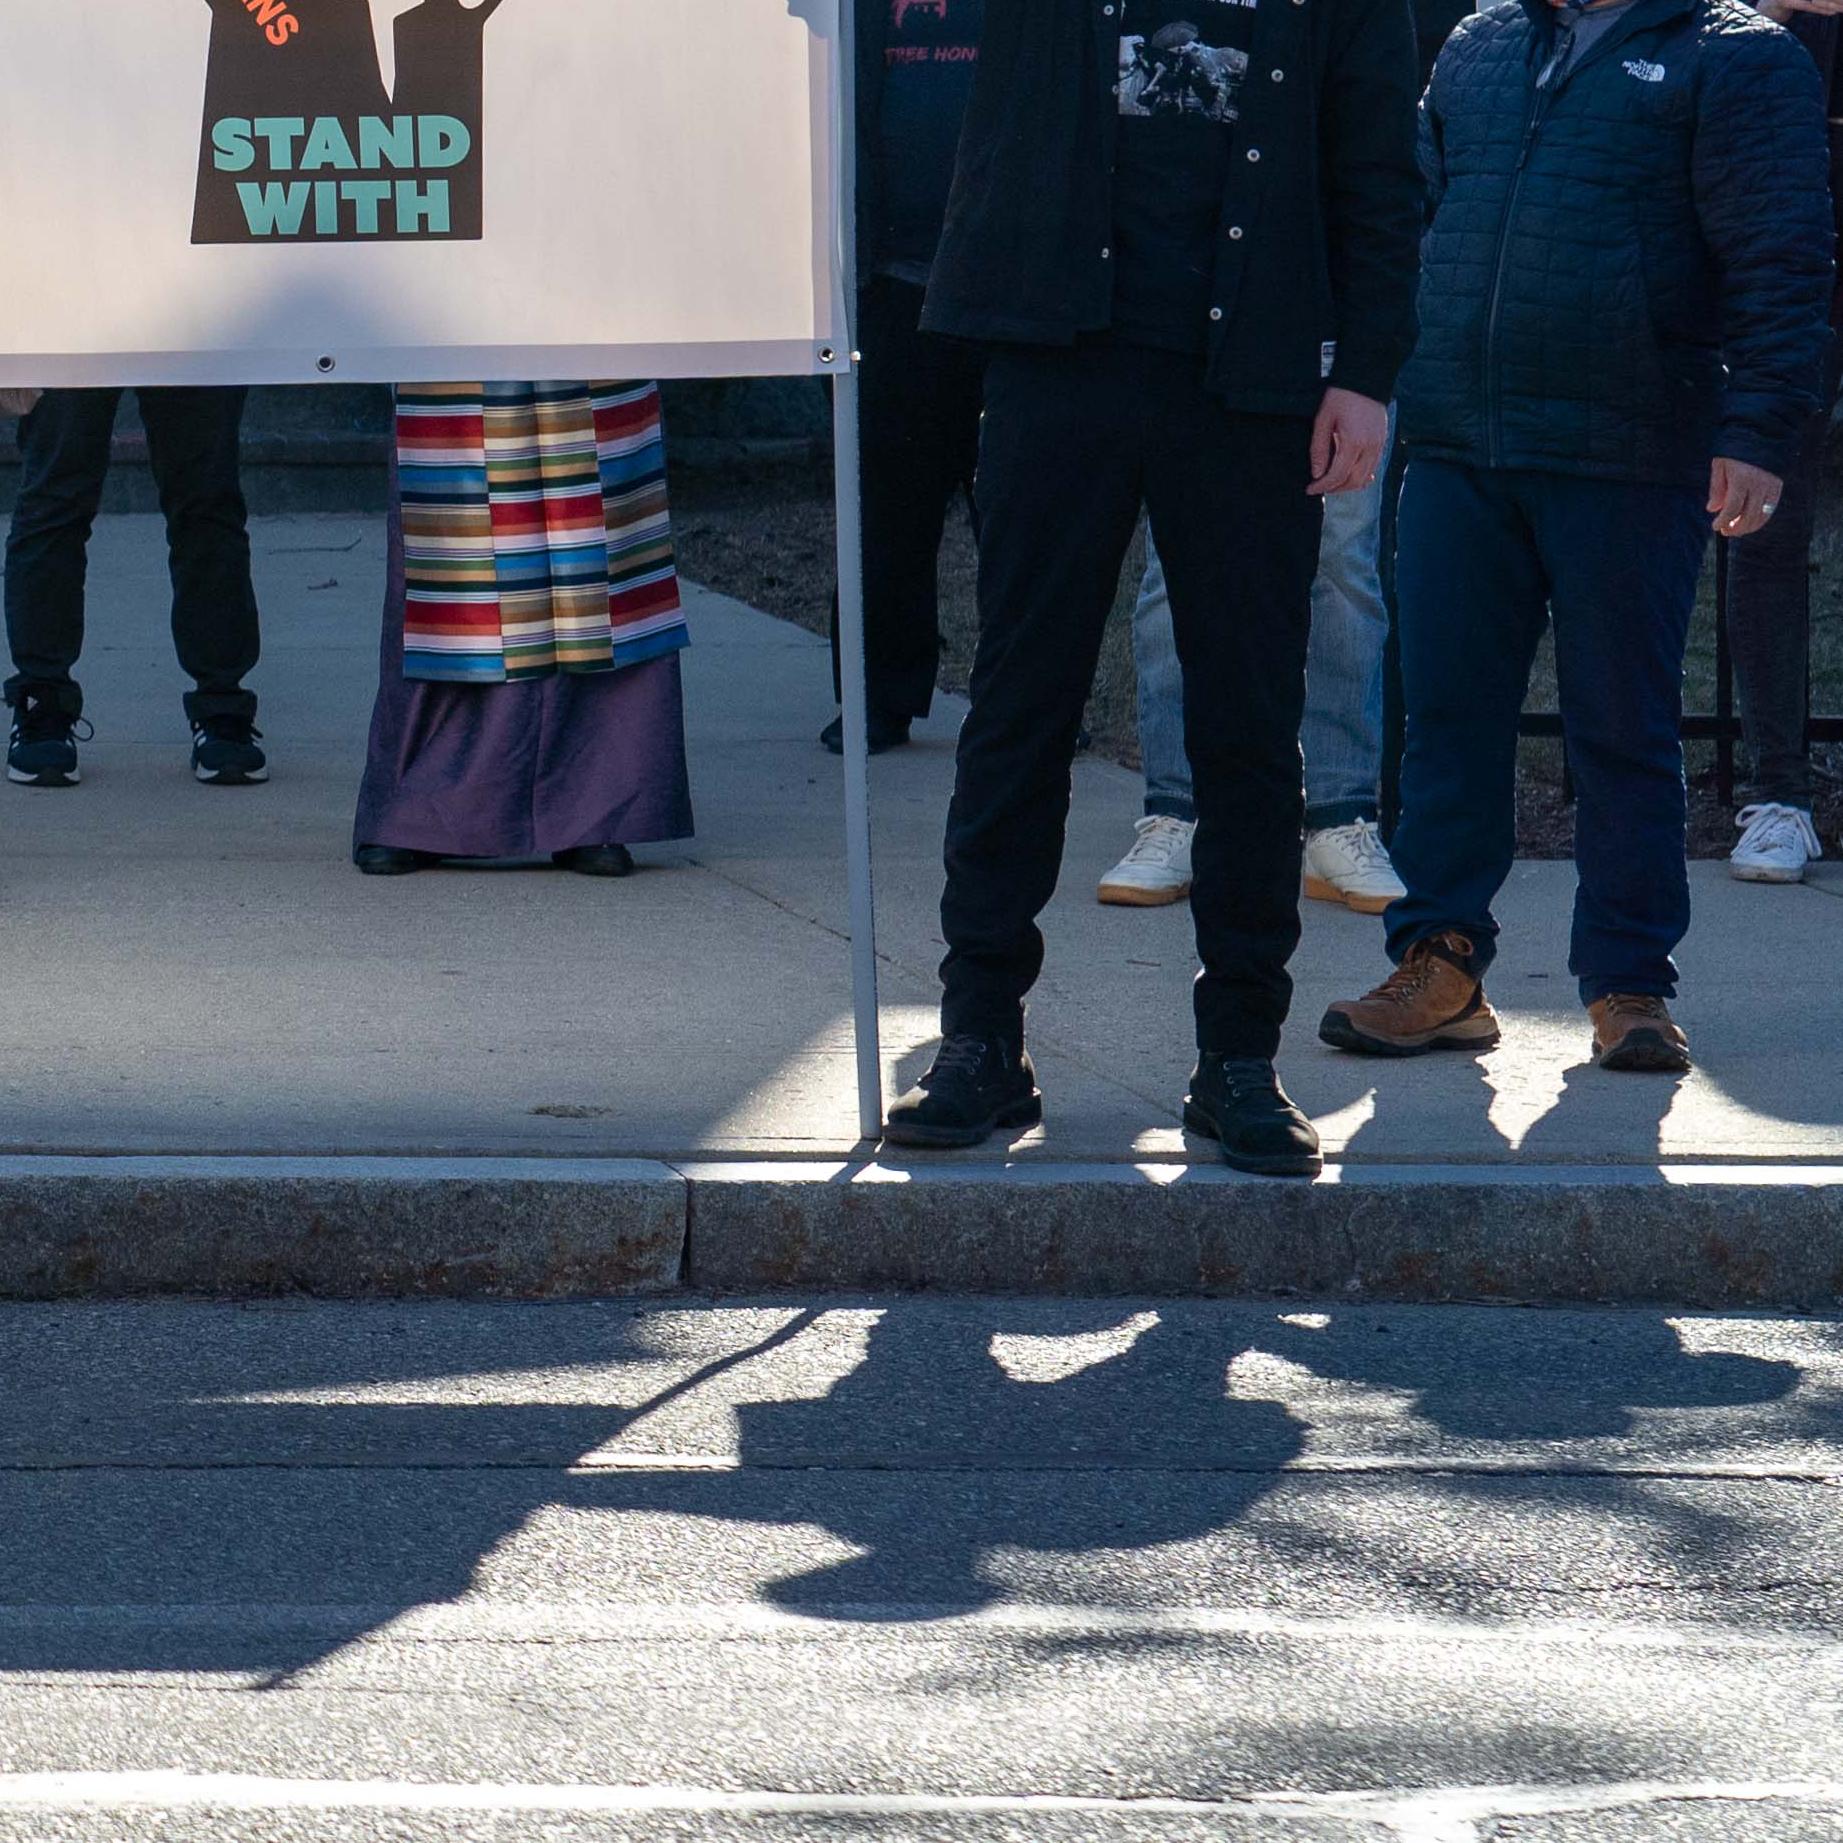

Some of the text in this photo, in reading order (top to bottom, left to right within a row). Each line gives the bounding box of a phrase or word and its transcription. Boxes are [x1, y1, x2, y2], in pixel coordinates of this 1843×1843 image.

[934, 46, 980, 62] HON
[212, 114, 471, 172] STAND
[235, 179, 451, 235] WITH
